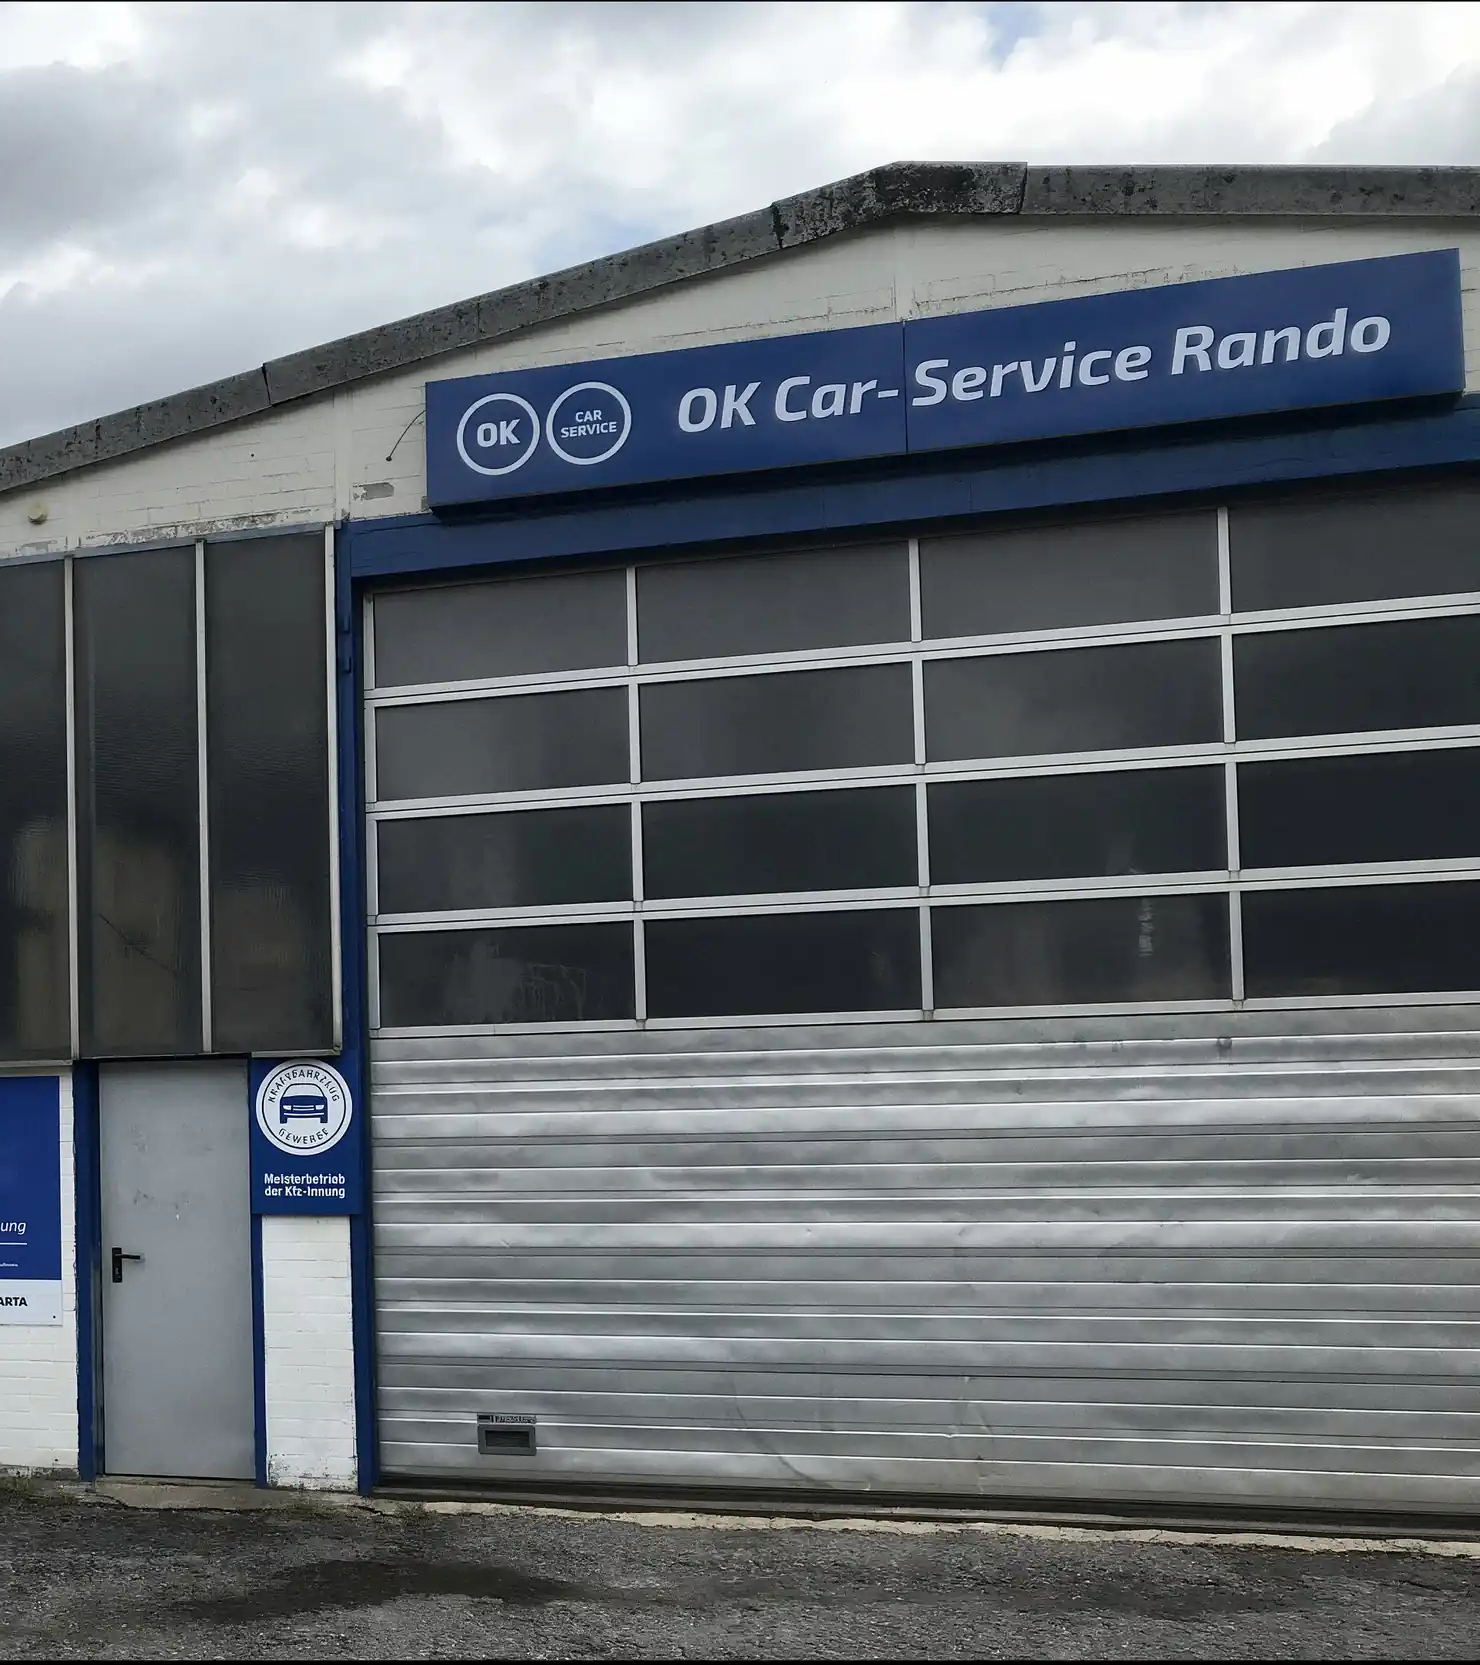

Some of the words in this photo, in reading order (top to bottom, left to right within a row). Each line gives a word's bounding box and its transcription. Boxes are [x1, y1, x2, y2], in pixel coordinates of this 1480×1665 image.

[678, 382, 762, 433] OK
[1171, 307, 1391, 376] Rando
[575, 409, 602, 423] CAR
[476, 419, 521, 448] OK
[560, 421, 618, 439] SERVICE
[278, 1127, 330, 1145] GEWERBE
[264, 1173, 346, 1185] Meisterbetrieb
[264, 1186, 283, 1197] der
[284, 1186, 346, 1199] Kfz-Innung
